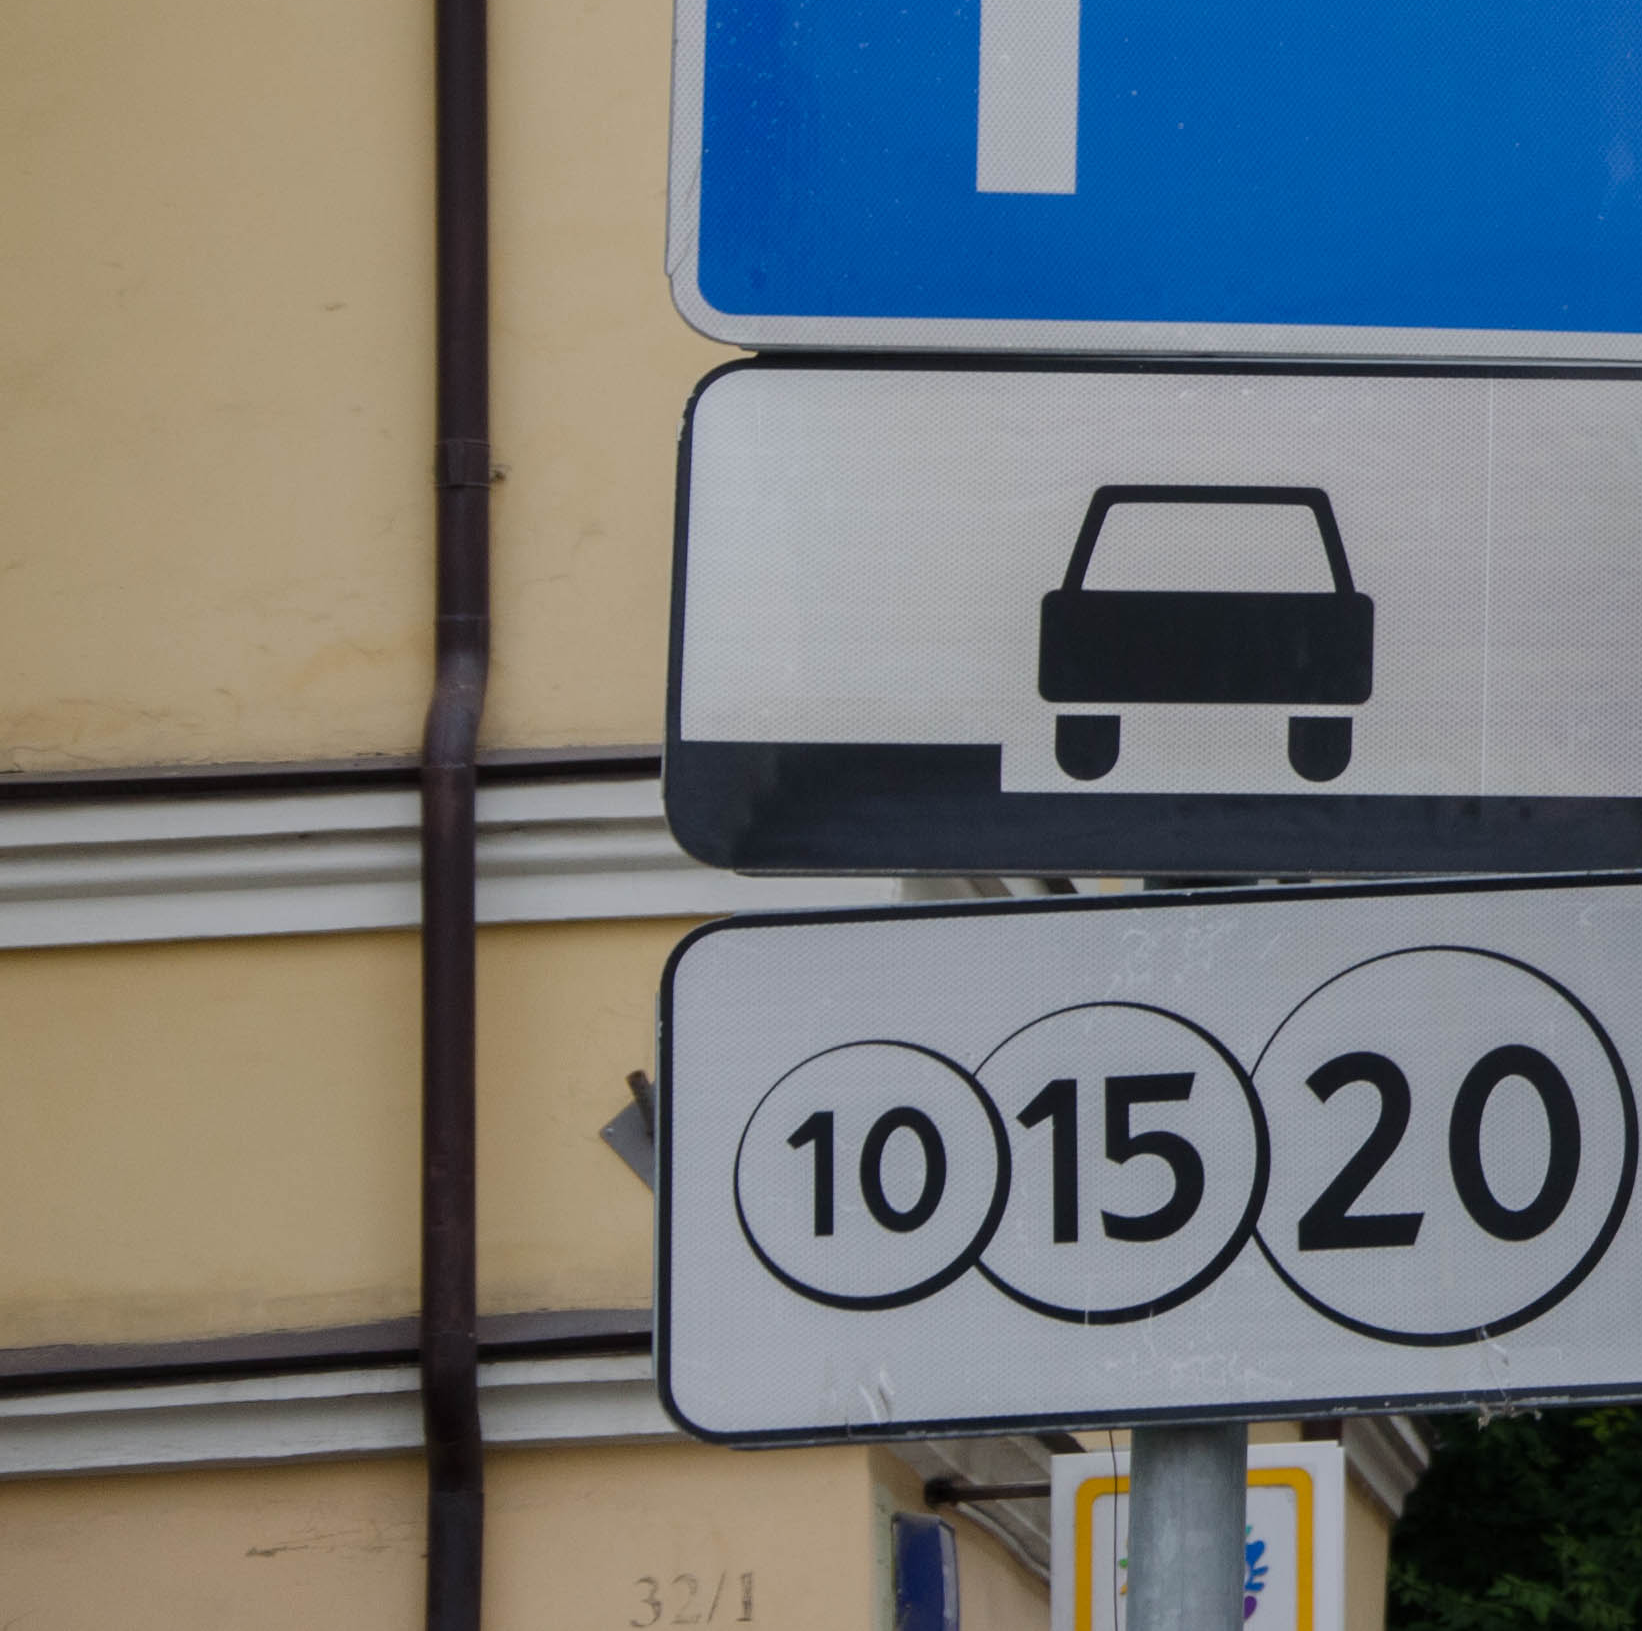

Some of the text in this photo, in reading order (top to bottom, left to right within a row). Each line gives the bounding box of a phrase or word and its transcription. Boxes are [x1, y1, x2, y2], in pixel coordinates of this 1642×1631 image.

[787, 1044, 1581, 1252] 10 15 20
[629, 1569, 754, 1628] 32/1
